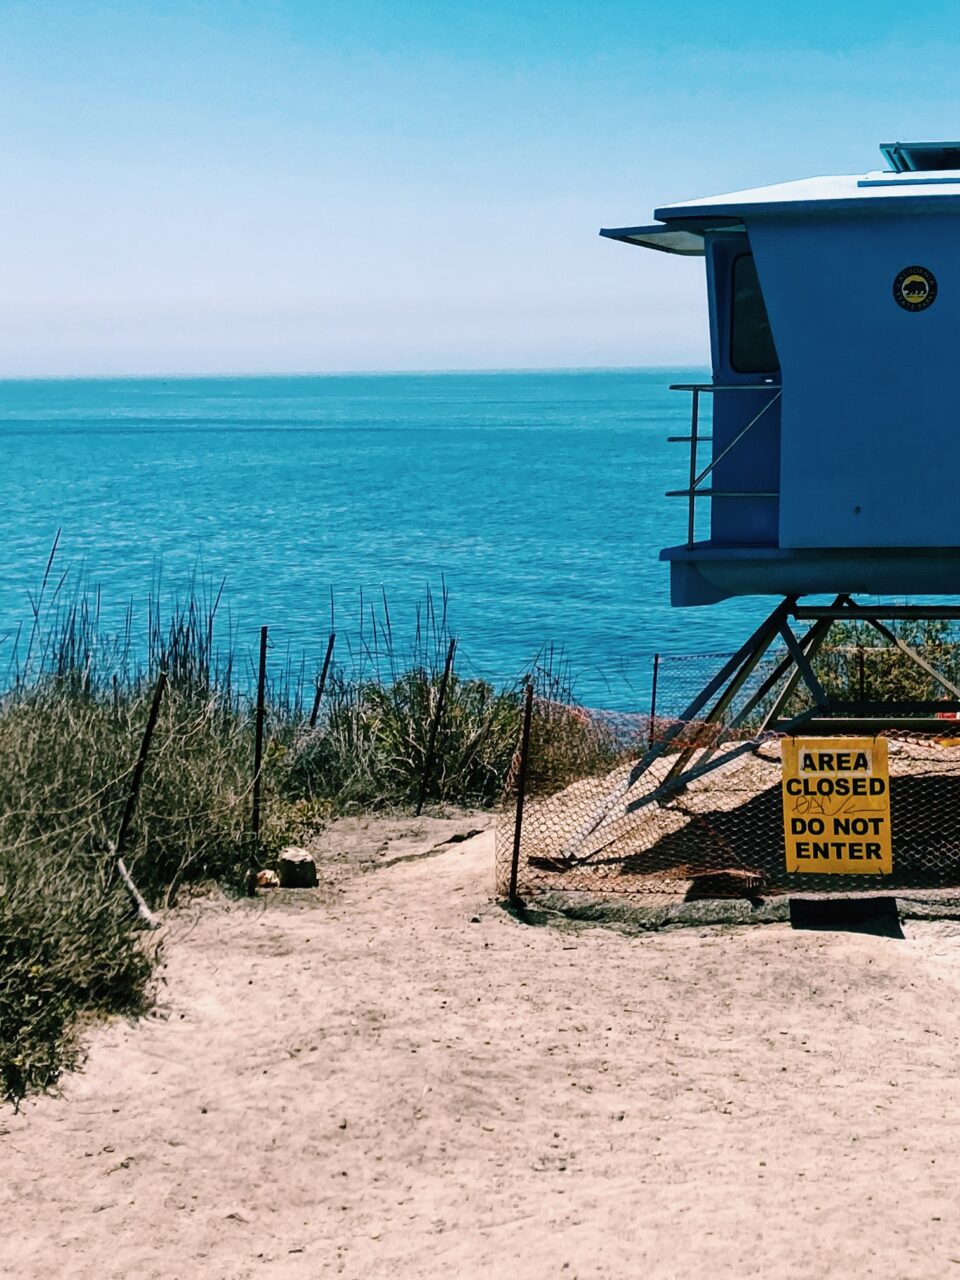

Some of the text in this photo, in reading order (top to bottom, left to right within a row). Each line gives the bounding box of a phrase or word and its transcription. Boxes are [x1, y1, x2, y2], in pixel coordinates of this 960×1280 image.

[801, 752, 869, 771] AREA
[786, 777, 886, 796] CLOSED
[790, 817, 884, 835] DO NOT
[795, 842, 883, 860] ENTER
